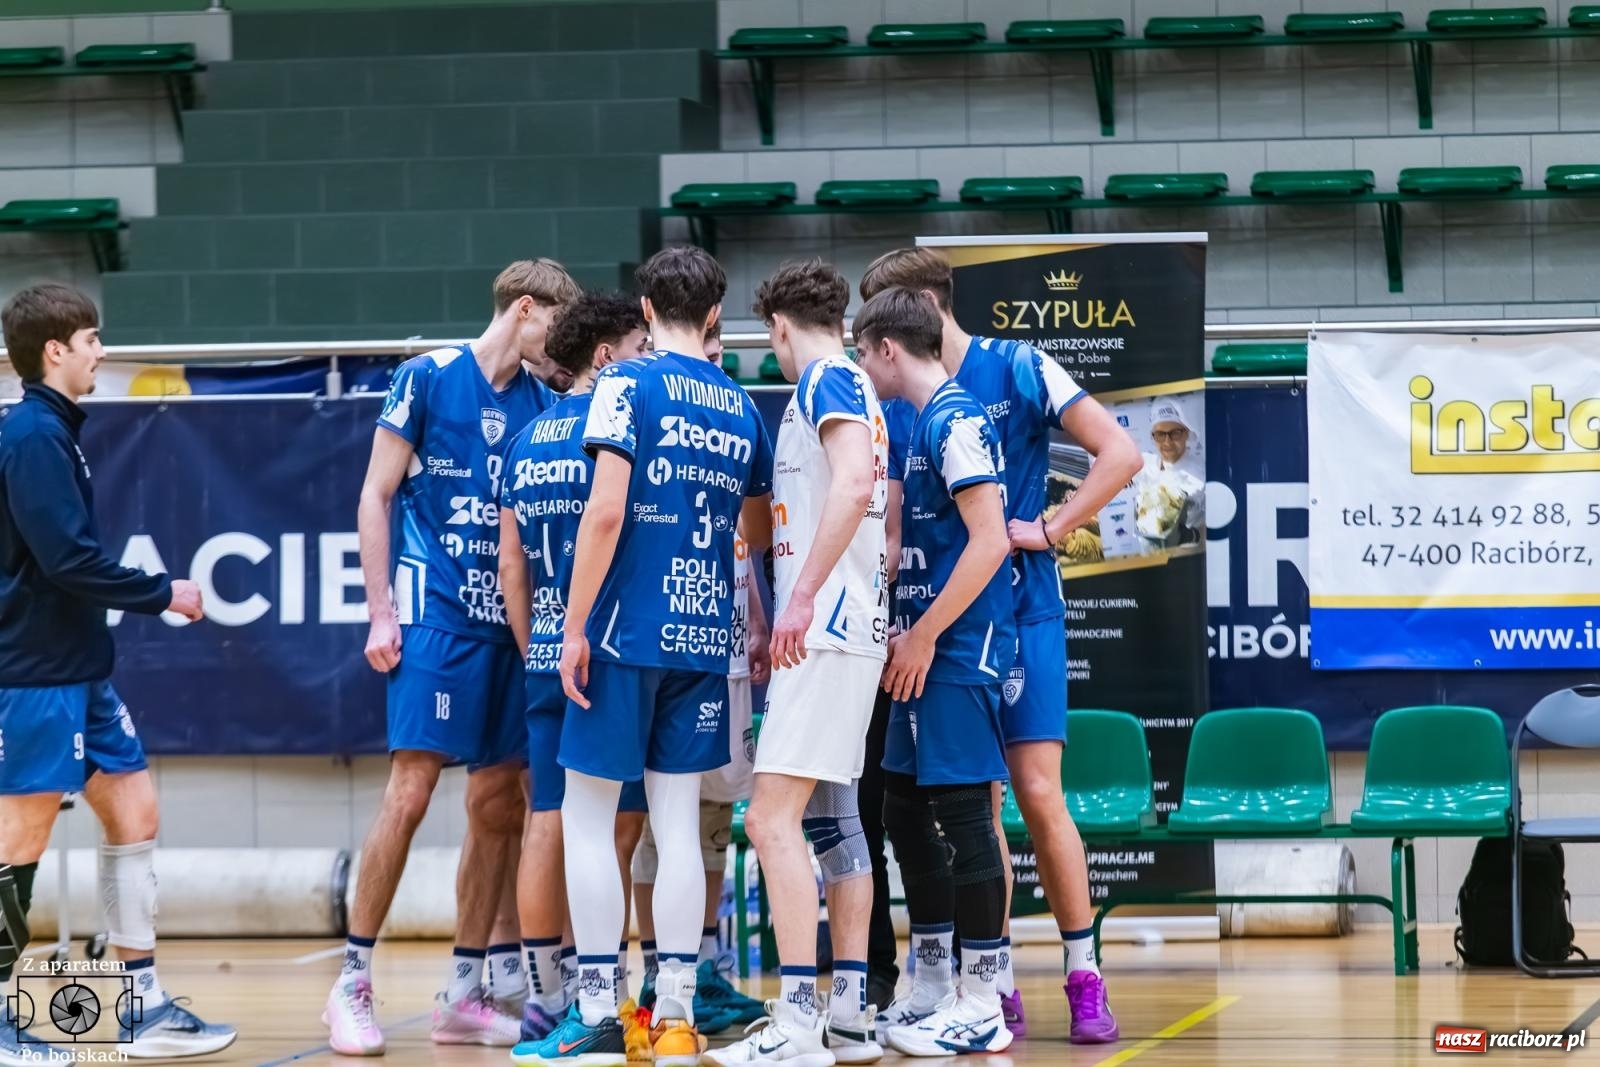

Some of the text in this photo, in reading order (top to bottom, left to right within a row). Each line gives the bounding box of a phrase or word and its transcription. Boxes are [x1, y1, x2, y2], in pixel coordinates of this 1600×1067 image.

[992, 299, 1136, 329] SZYPUŁA
[1037, 338, 1125, 350] MISTRZOWSKIE
[1078, 352, 1111, 364] Dobre
[662, 374, 744, 418] WYDMUCH
[530, 416, 581, 445] HAKERT
[656, 415, 752, 464] Steam
[427, 456, 454, 467] Exact
[513, 458, 587, 491] Steam
[445, 496, 500, 527] Ste
[633, 502, 658, 513] Exact
[692, 490, 713, 549] 3
[1342, 506, 1382, 527] tel.
[1391, 505, 1422, 528] 32
[1432, 505, 1483, 527] 414
[1491, 505, 1526, 527] 92
[1532, 503, 1571, 527] 88,
[1362, 540, 1592, 567] 47-400 Racibórz,
[671, 557, 717, 579] POLI
[669, 594, 720, 617] NIKA
[1064, 610, 1086, 620] TELU
[1067, 598, 1139, 609] TWOJEJ CUKIERNI,
[1065, 628, 1124, 639] OŚWIADCZENIE
[1009, 669, 1022, 679] WID
[435, 691, 450, 720] 18
[74, 732, 84, 760] 9
[1089, 869, 1138, 882] Orzechem
